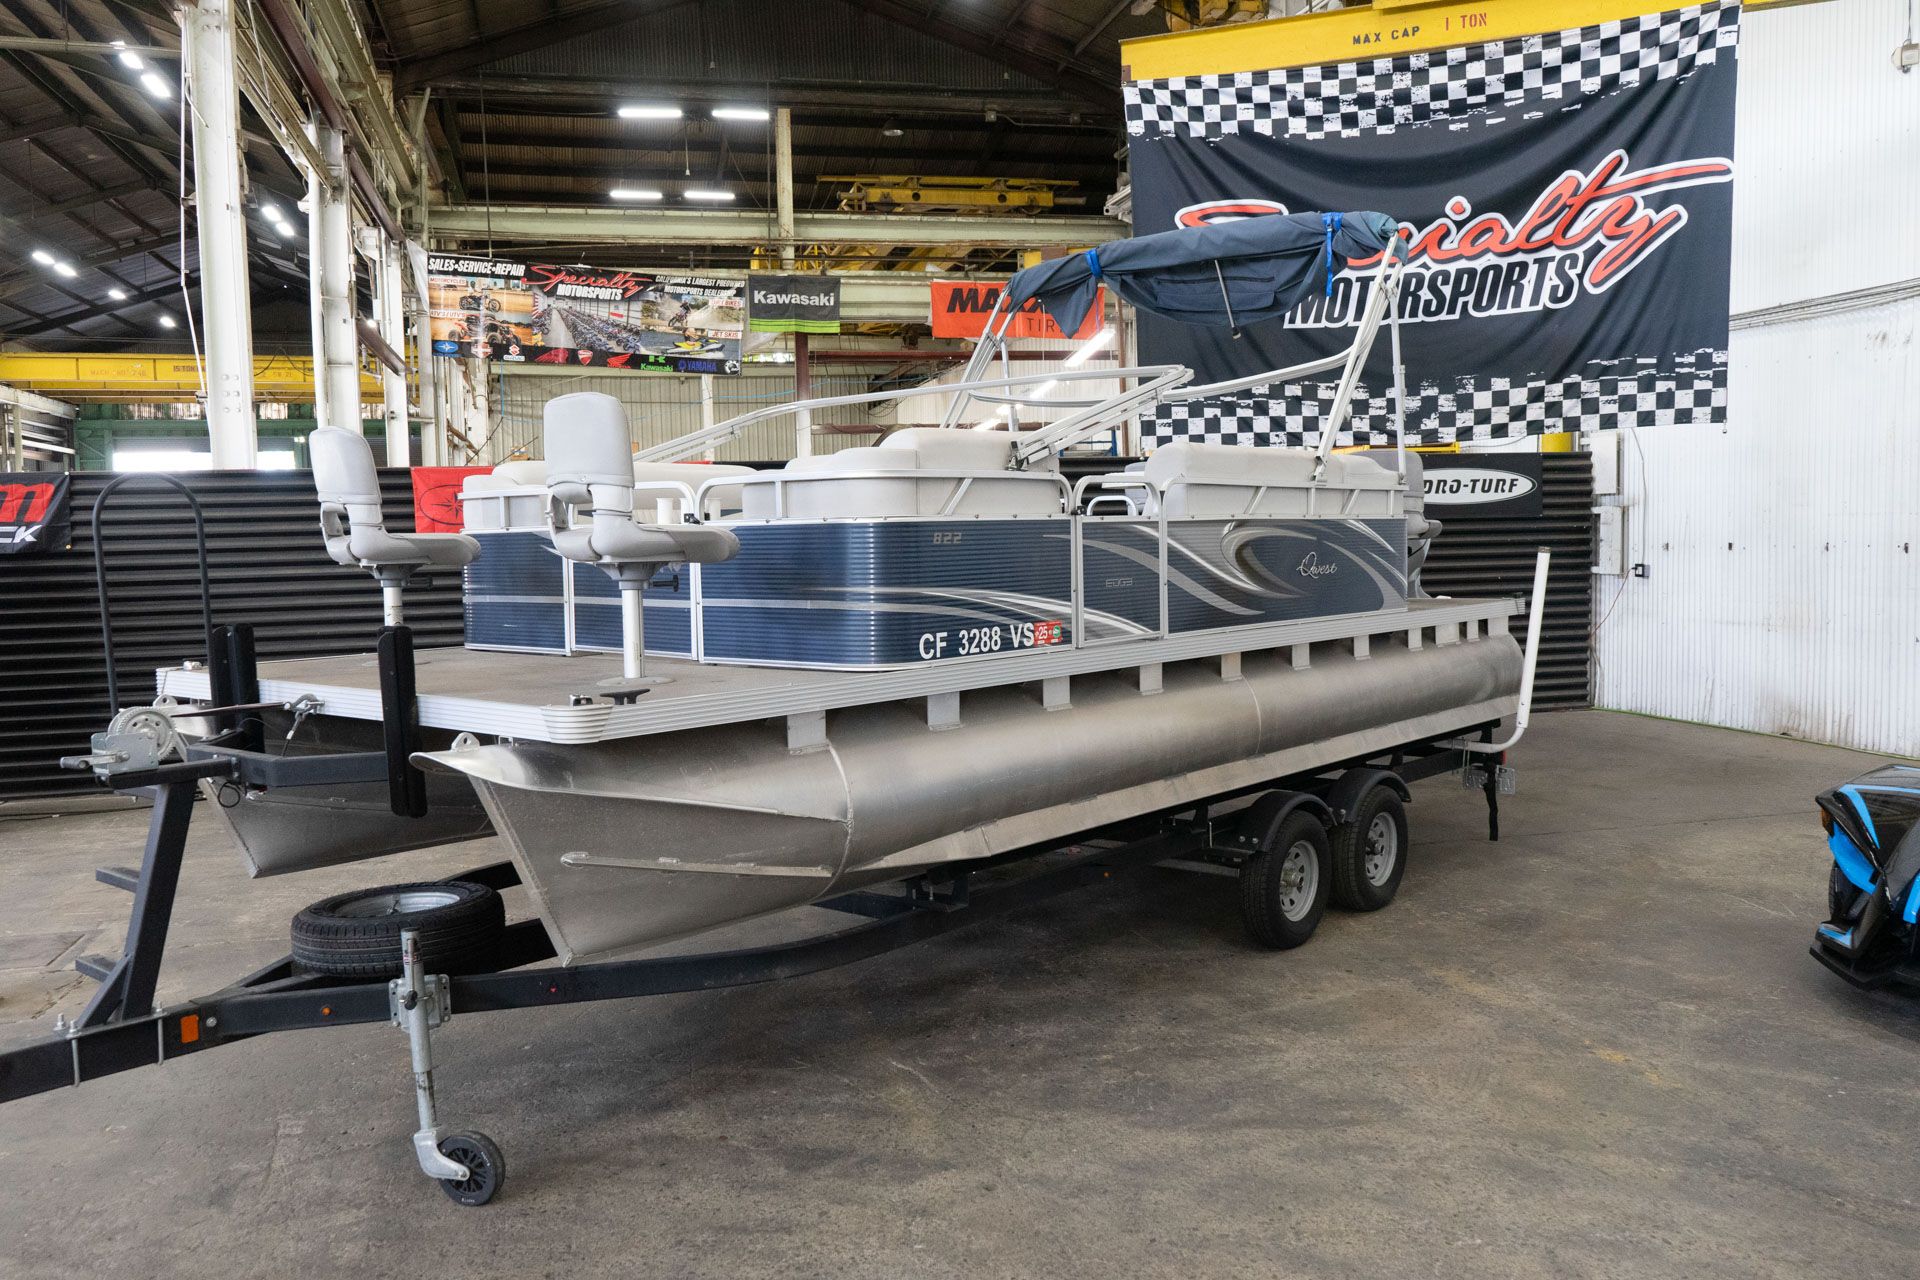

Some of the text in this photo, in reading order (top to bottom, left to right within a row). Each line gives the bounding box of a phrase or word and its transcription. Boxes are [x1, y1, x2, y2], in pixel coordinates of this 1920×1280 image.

[1460, 12, 1487, 28] TON
[1353, 26, 1420, 45] MAX CAP
[521, 264, 653, 298] Specialty
[692, 277, 716, 287] LARGEST
[556, 284, 623, 300] MOTORSPORTS
[664, 286, 704, 296] MOTORSPORTS
[754, 290, 835, 306] Kawasaki
[1283, 252, 1583, 329] MOTRSPORTS
[640, 363, 673, 373] Kawasaki
[686, 360, 717, 372] YAMAHA
[933, 532, 962, 544] 822
[1296, 551, 1338, 579] Qwest
[919, 622, 1034, 659] CF 3288 VS
